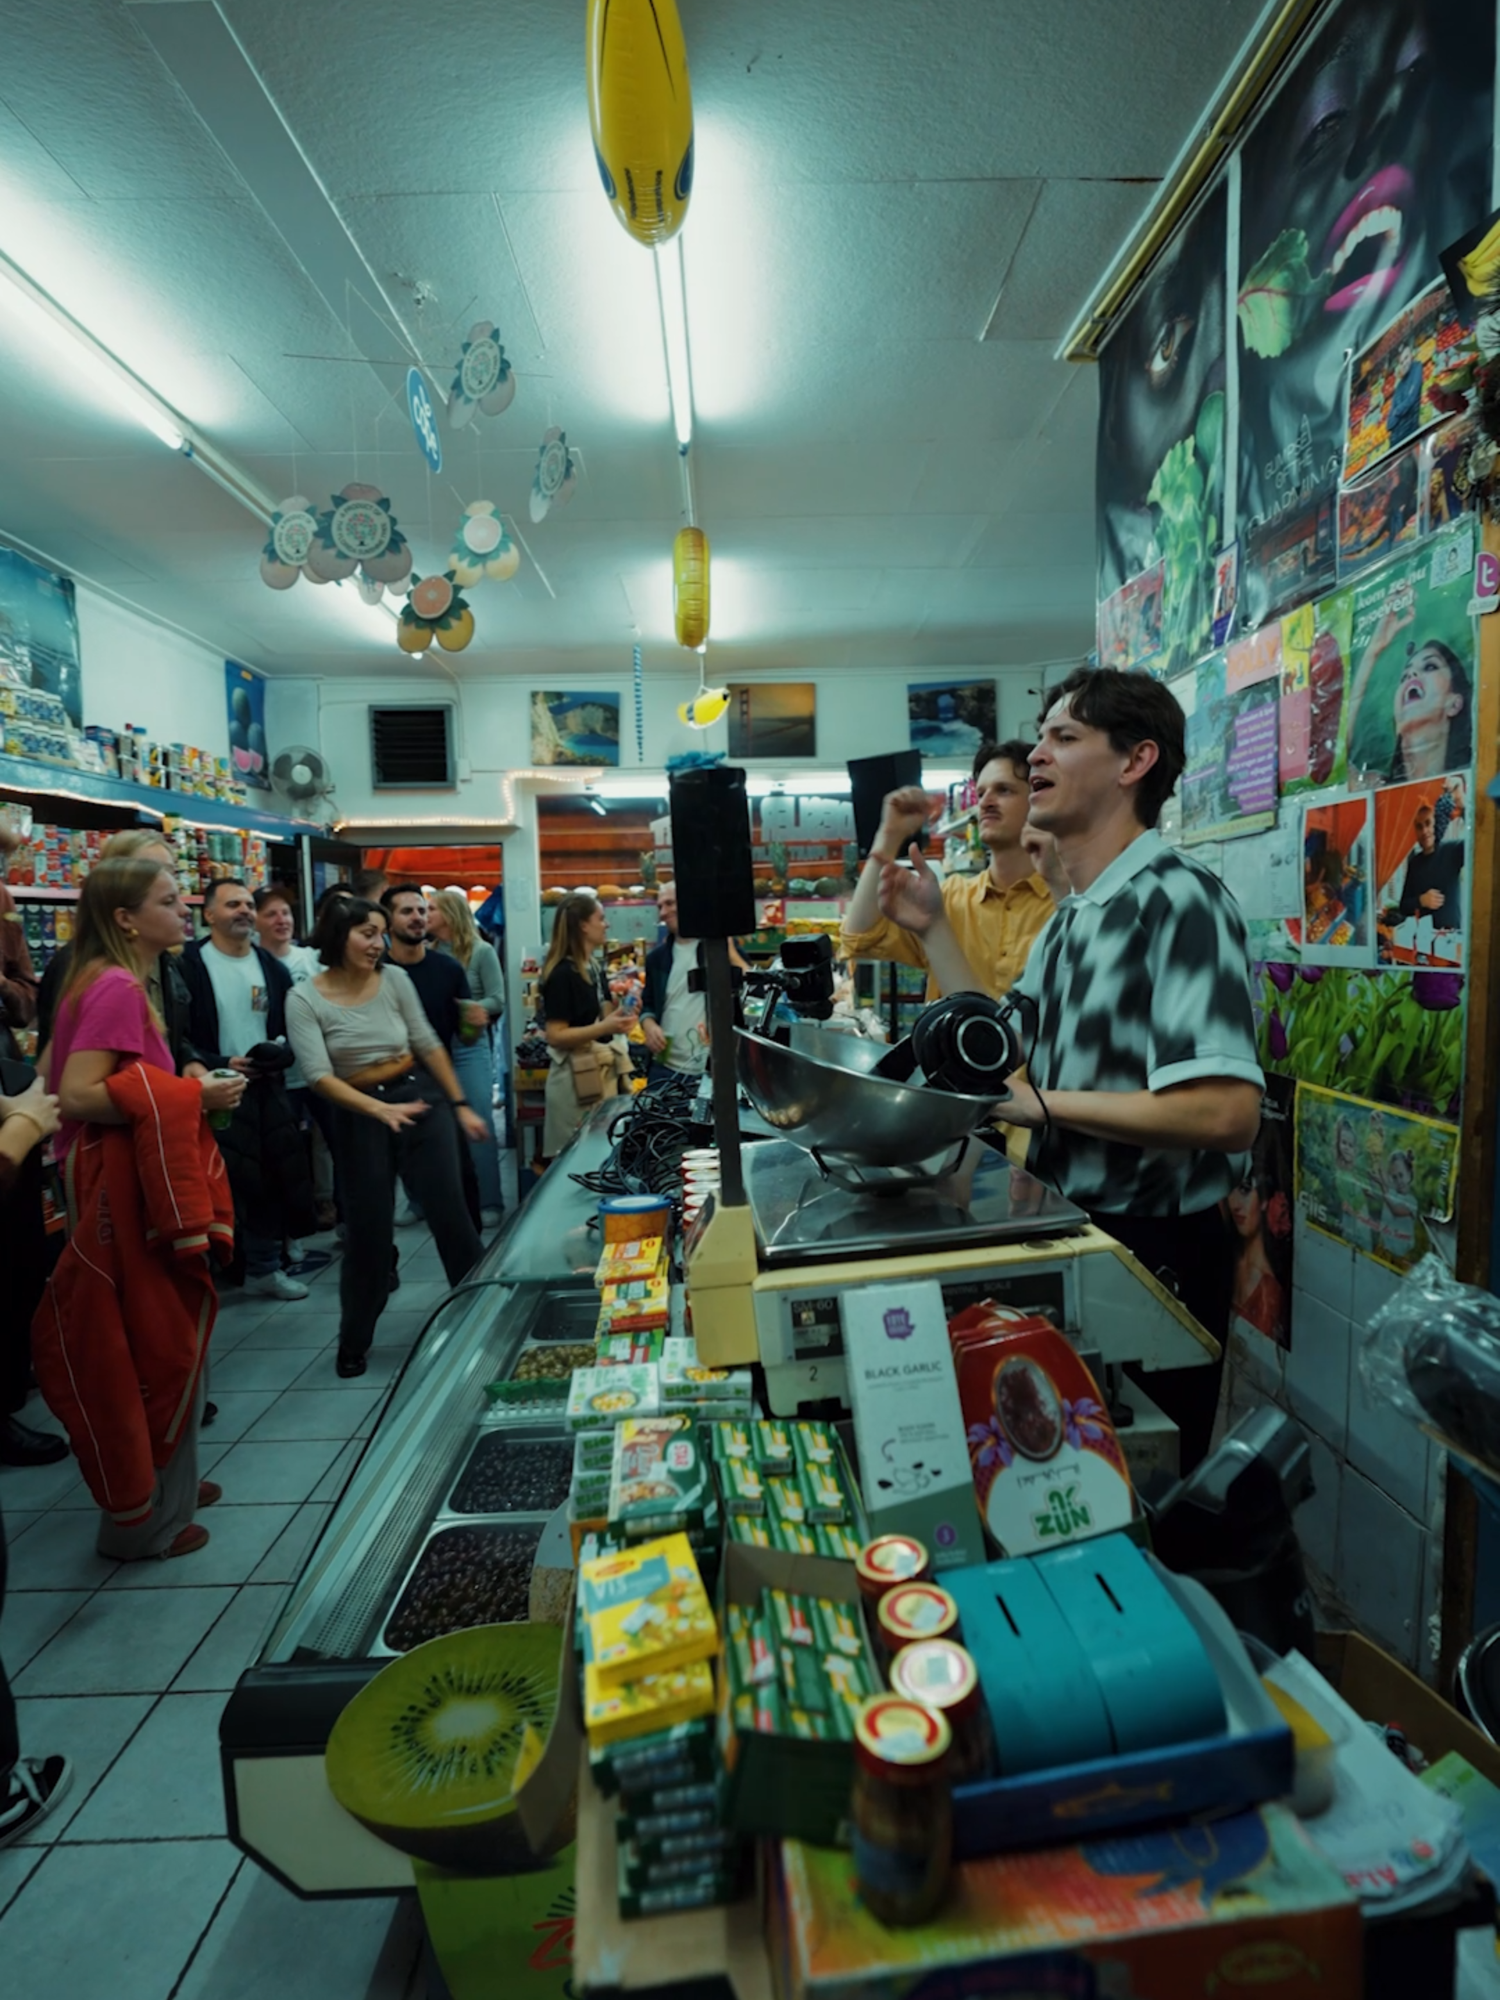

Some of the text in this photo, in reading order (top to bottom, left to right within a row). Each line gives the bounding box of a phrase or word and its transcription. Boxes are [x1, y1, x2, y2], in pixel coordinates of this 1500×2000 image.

[1357, 587, 1386, 610] kom
[1388, 577, 1405, 595] ze
[809, 1366, 818, 1382] 2
[865, 1362, 943, 1380] BLACK GARLIC
